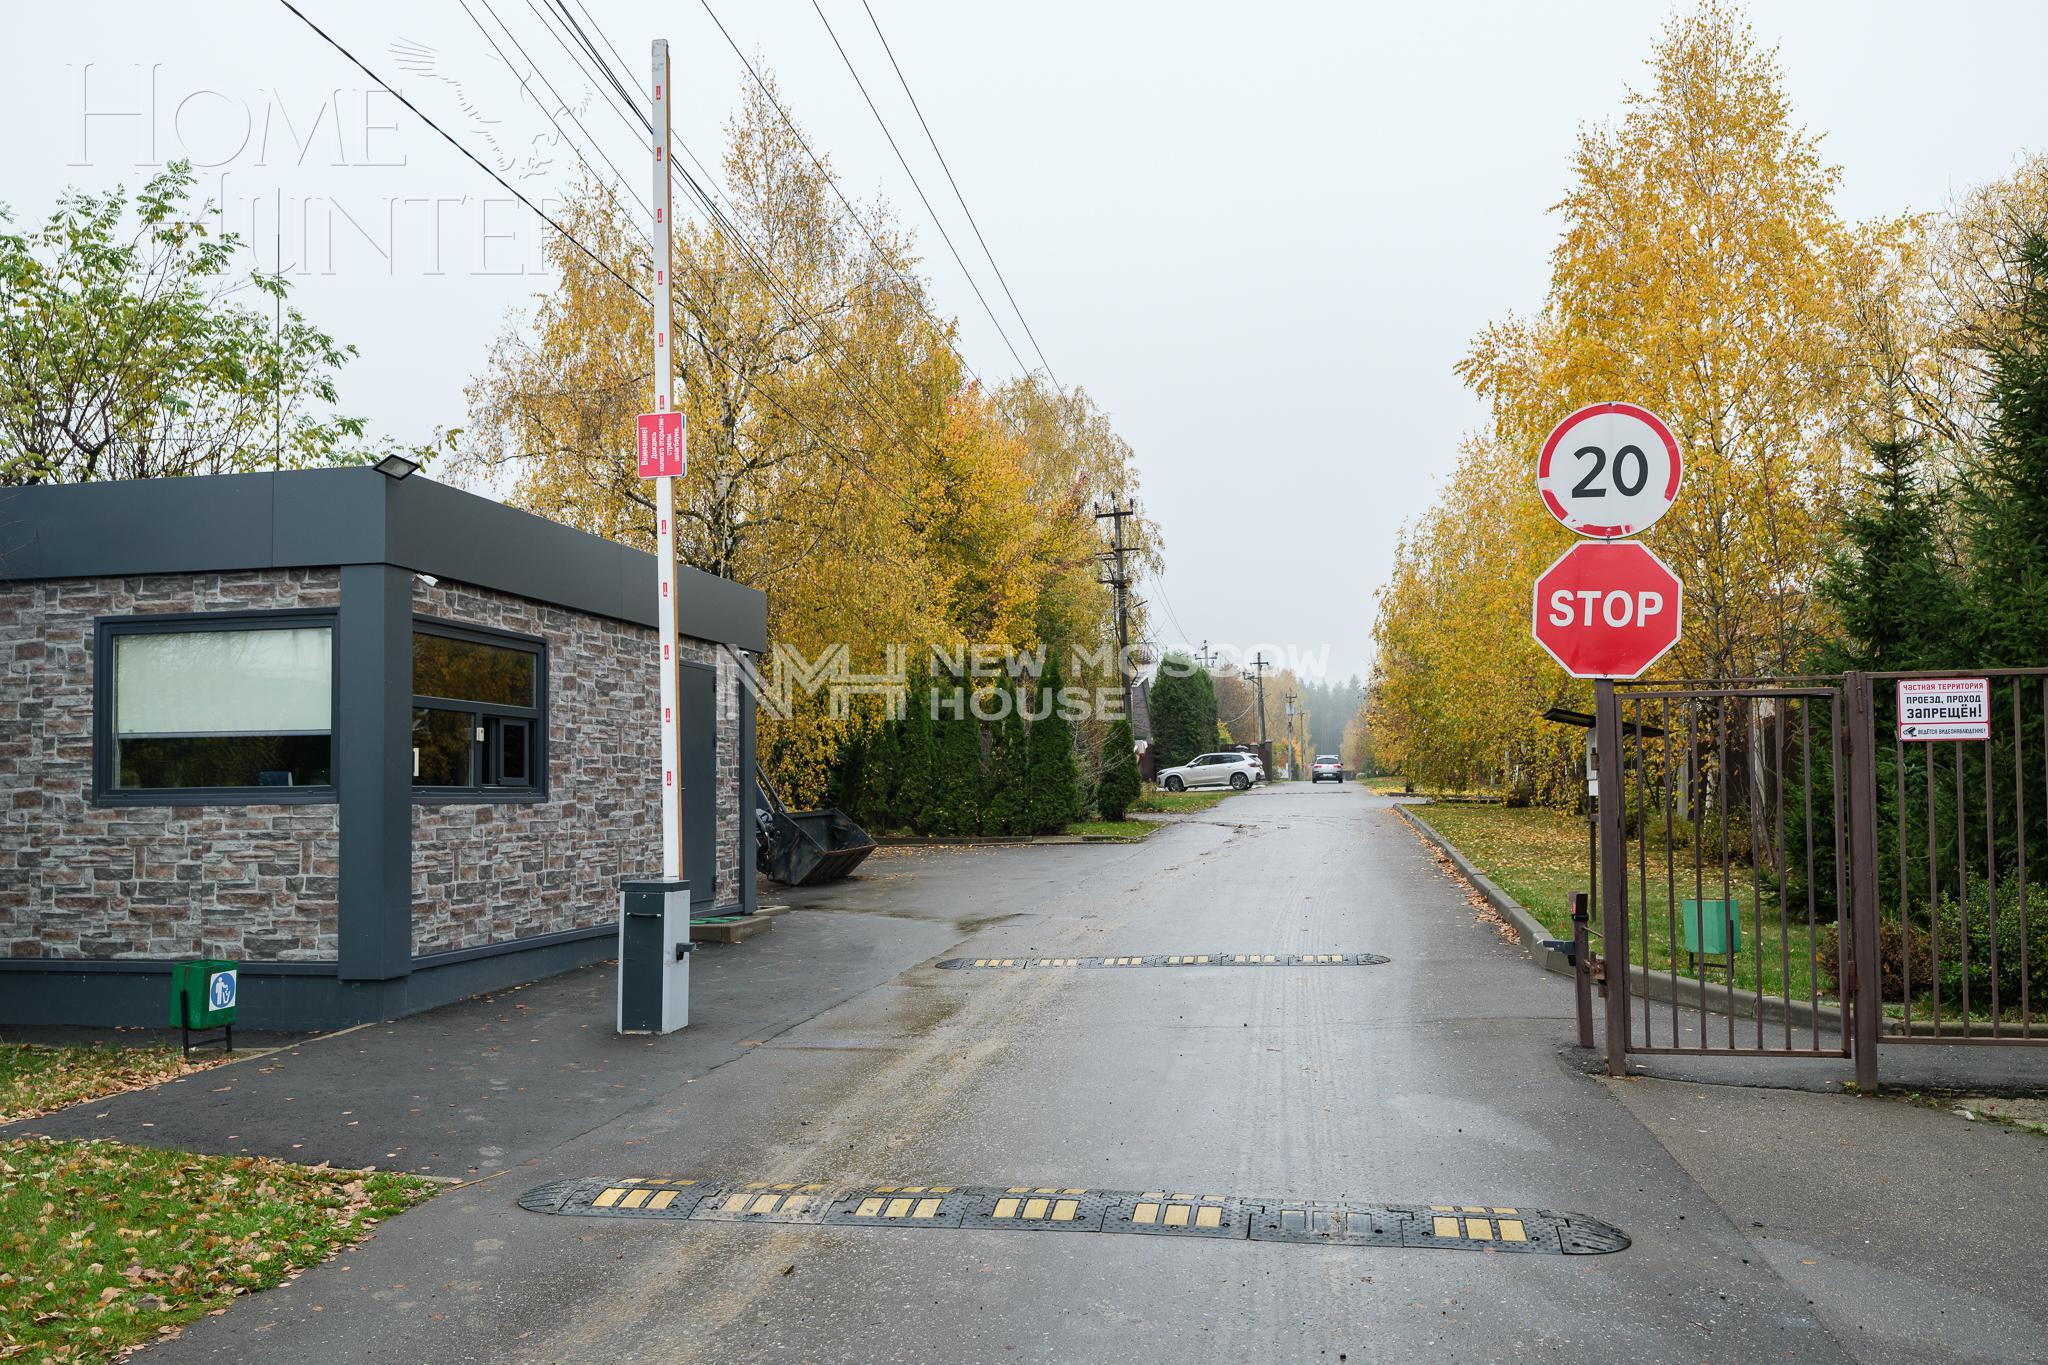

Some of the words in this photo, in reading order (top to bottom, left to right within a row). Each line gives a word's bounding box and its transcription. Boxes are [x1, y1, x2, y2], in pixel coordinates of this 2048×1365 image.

[641, 426, 649, 466] Внимание!
[1571, 444, 1649, 498] 20
[1549, 589, 1664, 628] STOP
[1903, 683, 1936, 691] ЧАСТНАЯ
[1938, 682, 1984, 690] ТЕРРИТОРИЯ
[1906, 695, 1944, 704] ПРОЕЗД,
[1946, 694, 1982, 704] ПРОХОД
[1906, 704, 1982, 719] ЗАПРЕЩЁН!
